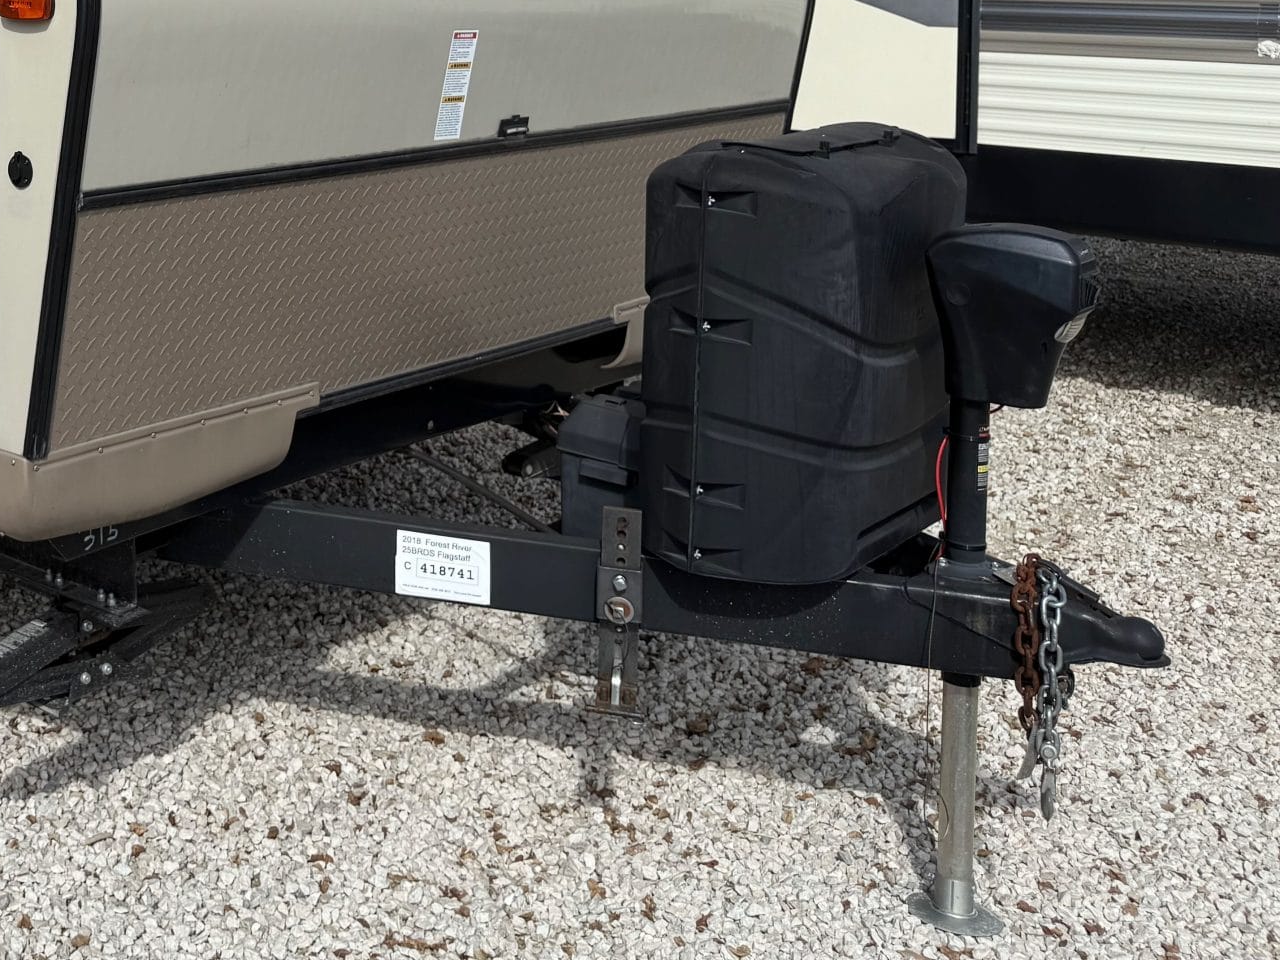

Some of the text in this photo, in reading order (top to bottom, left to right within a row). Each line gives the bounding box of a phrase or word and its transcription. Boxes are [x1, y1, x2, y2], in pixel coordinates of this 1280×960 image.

[402, 535, 472, 552] 2018 Forest River
[437, 550, 471, 561] Flagstaff
[403, 561, 475, 581] C 418741
